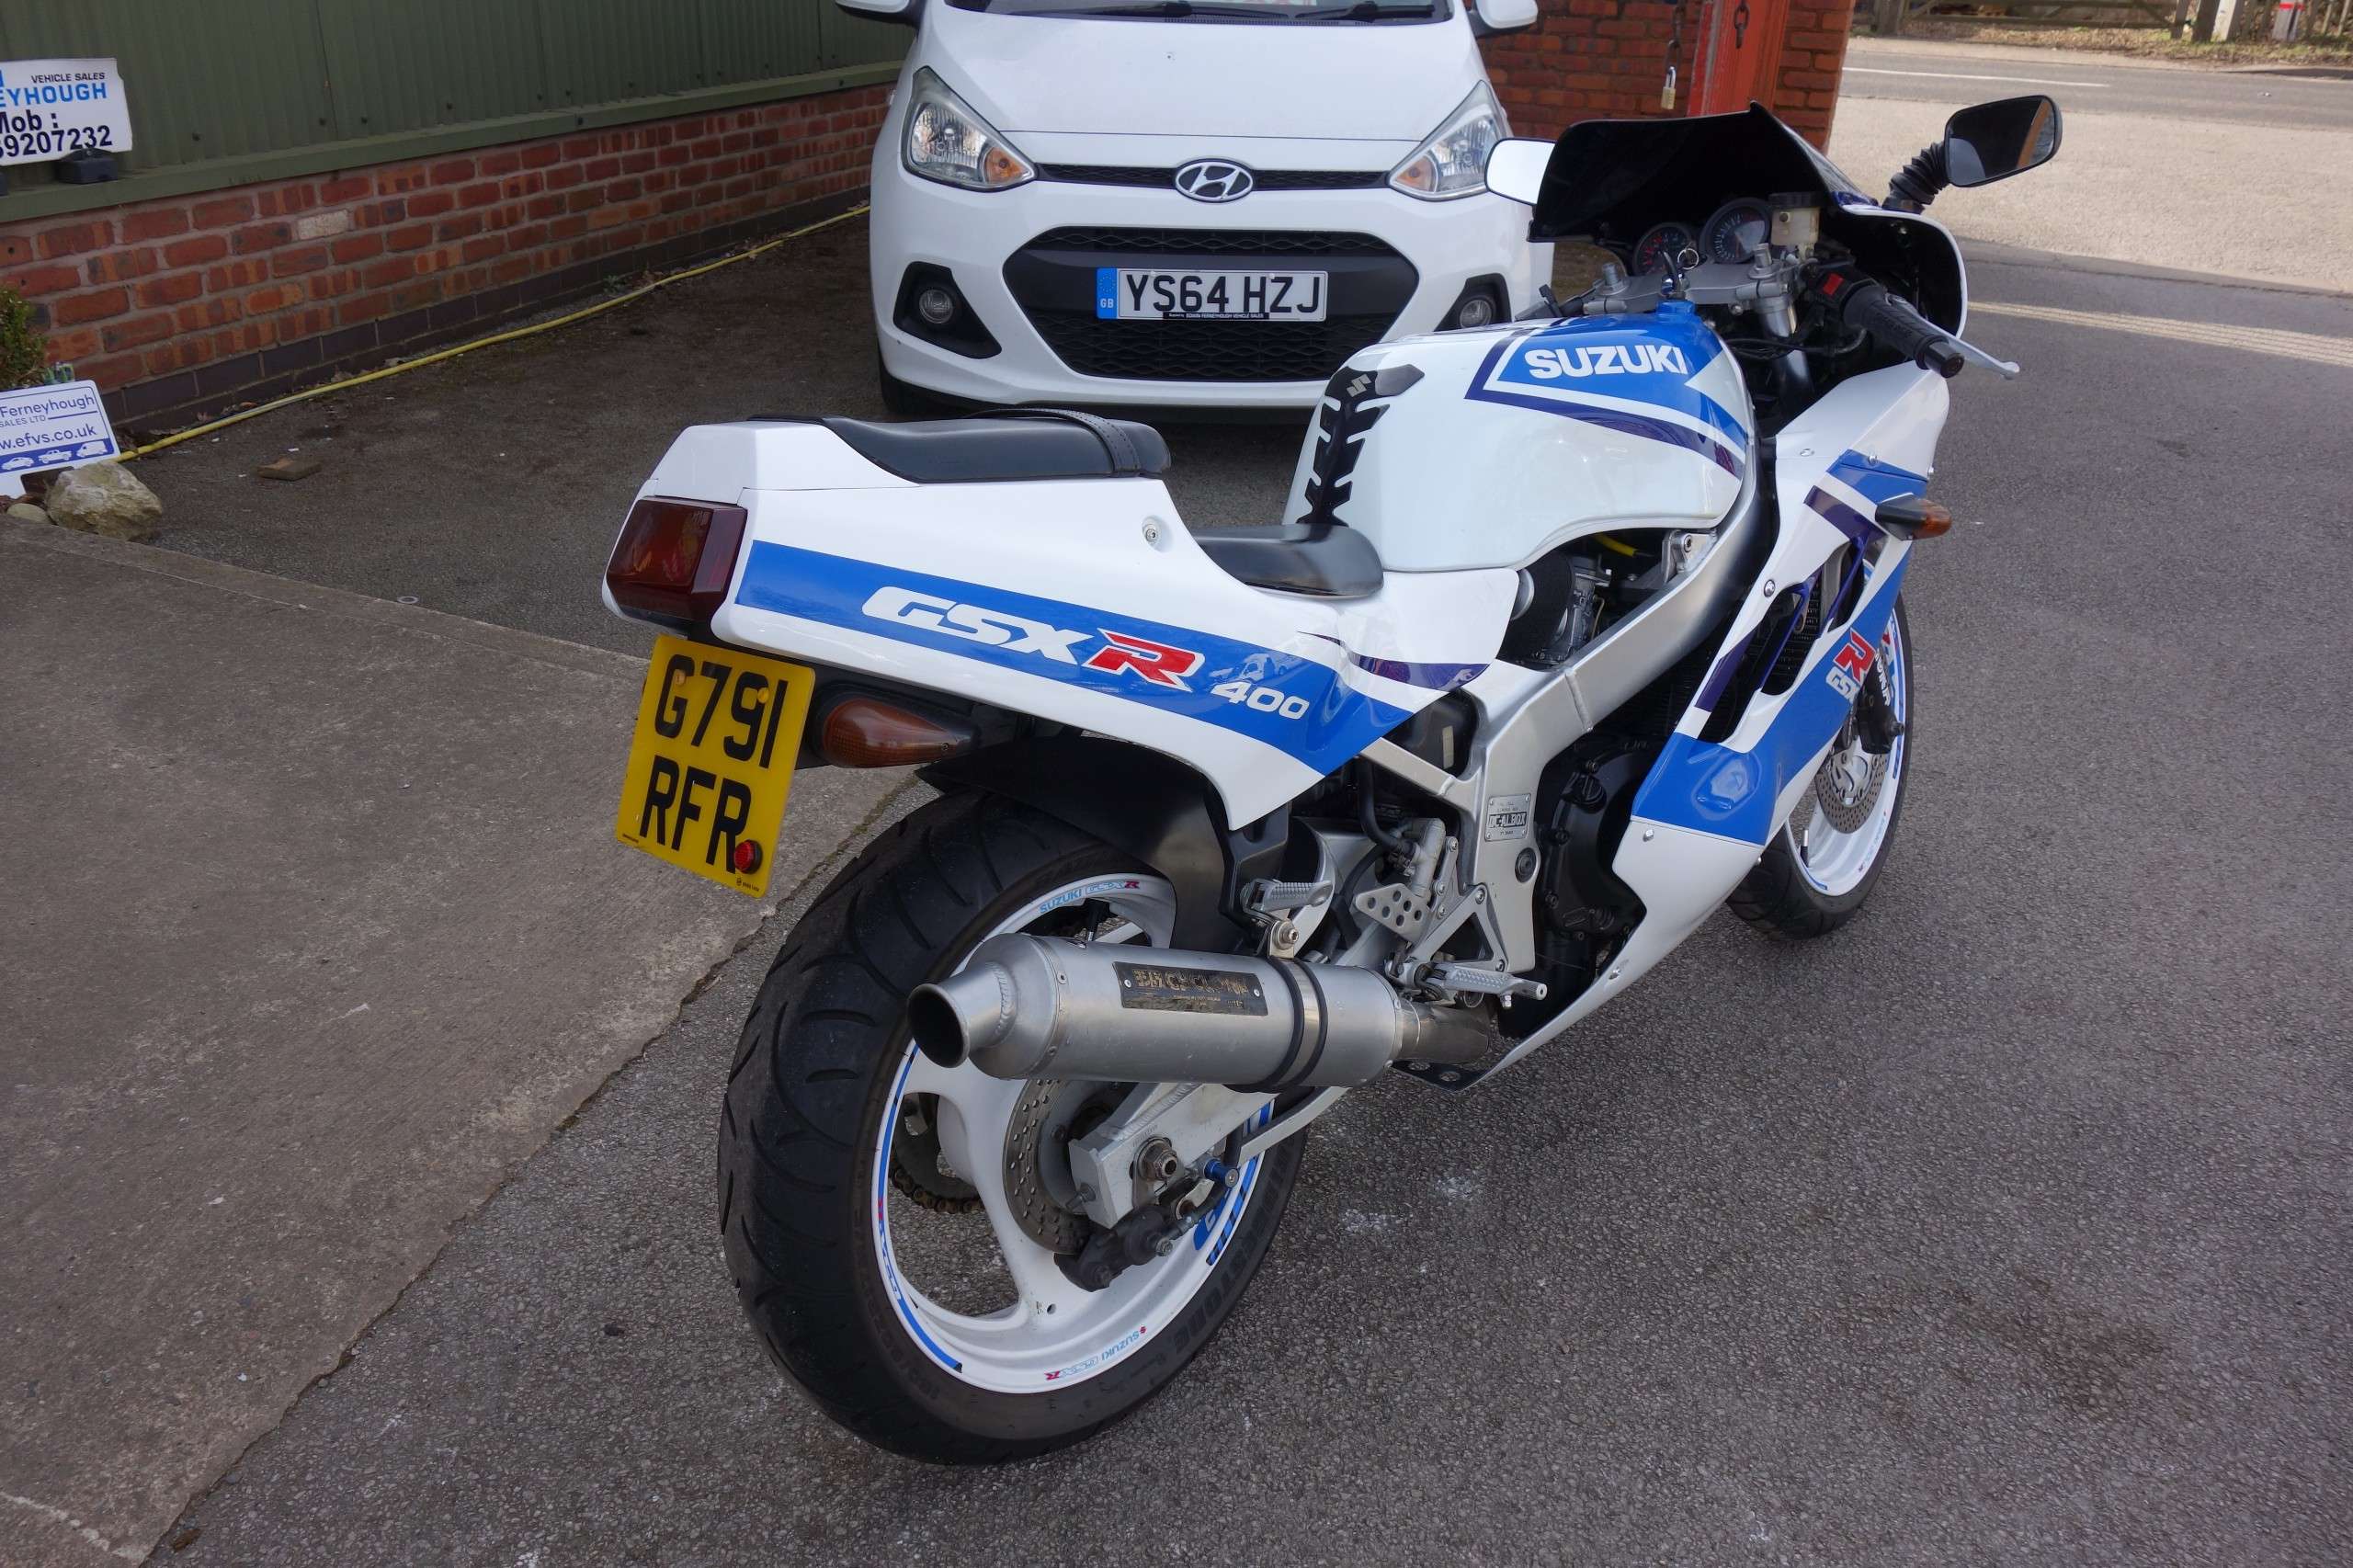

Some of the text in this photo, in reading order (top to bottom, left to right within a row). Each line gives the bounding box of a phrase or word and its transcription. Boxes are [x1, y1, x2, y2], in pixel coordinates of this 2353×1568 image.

[31, 72, 106, 84] VEHICLE SALES
[0, 125, 112, 158] 9207232
[1099, 298, 1114, 309] GB
[1126, 274, 1321, 313] YS64 HZJ
[1525, 345, 1688, 380] SUZUKI
[0, 394, 95, 417] Ferneyhough
[29, 415, 46, 424] LTD
[654, 653, 789, 769] G791
[1210, 681, 1309, 721] 400
[639, 755, 752, 874] RFR
[1039, 888, 1083, 915] SUZUKI
